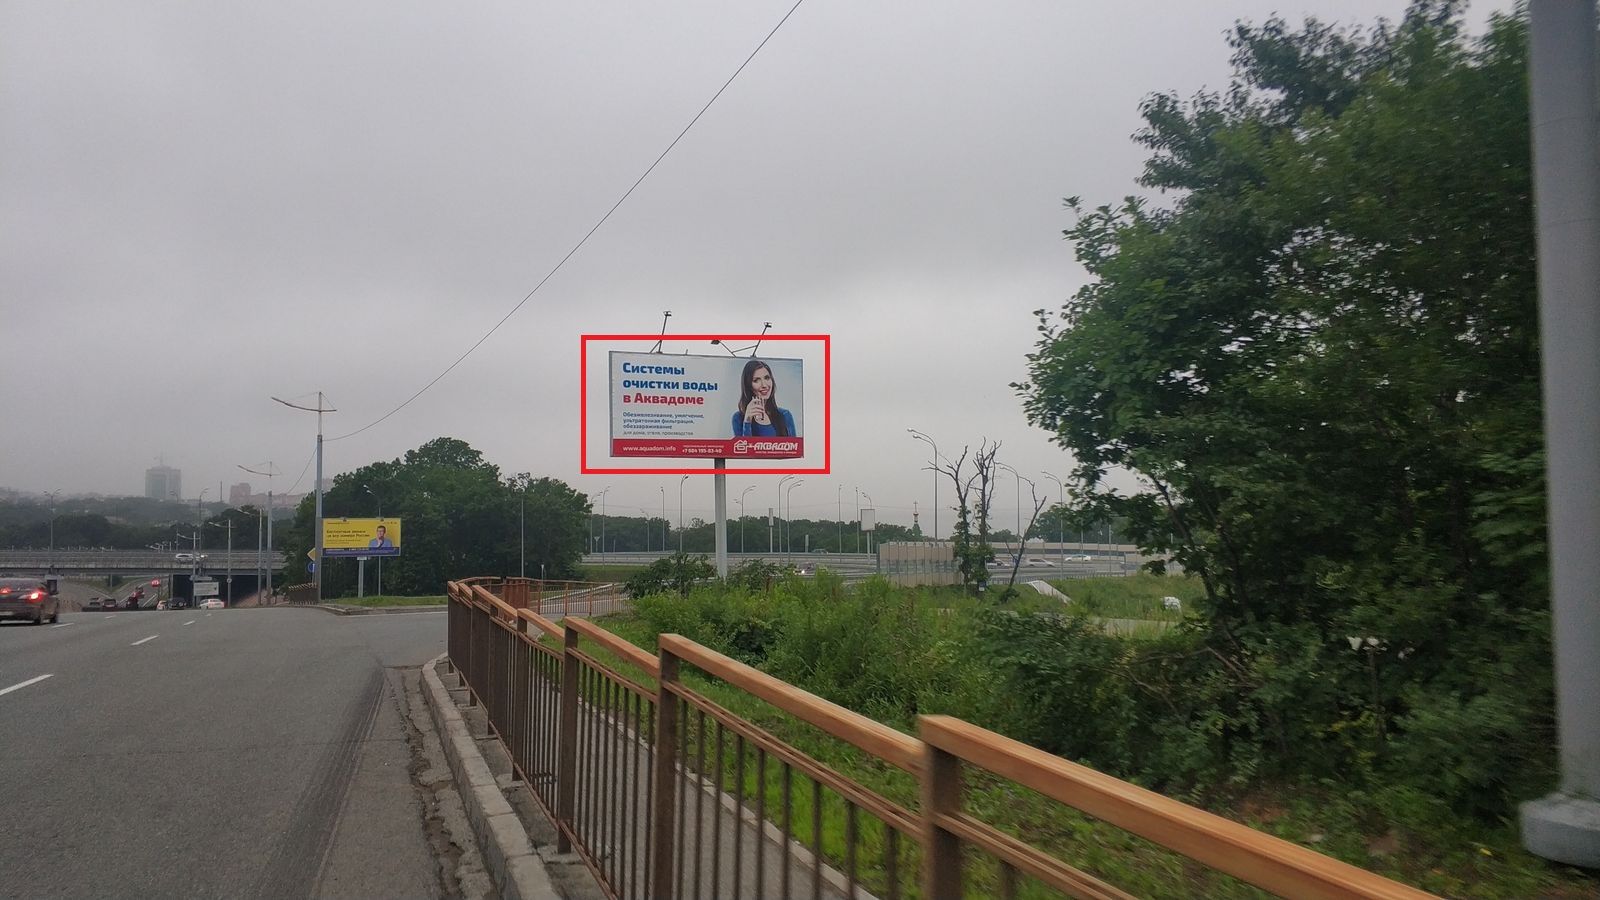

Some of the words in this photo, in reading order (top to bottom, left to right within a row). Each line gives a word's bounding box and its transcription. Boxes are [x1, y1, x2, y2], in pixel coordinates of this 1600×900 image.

[622, 362, 685, 375] Системы
[622, 379, 680, 390] очистки
[682, 381, 718, 392] воды
[623, 394, 631, 403] в
[634, 392, 704, 406] Аквадоме
[754, 442, 799, 451] АКВАДОМ
